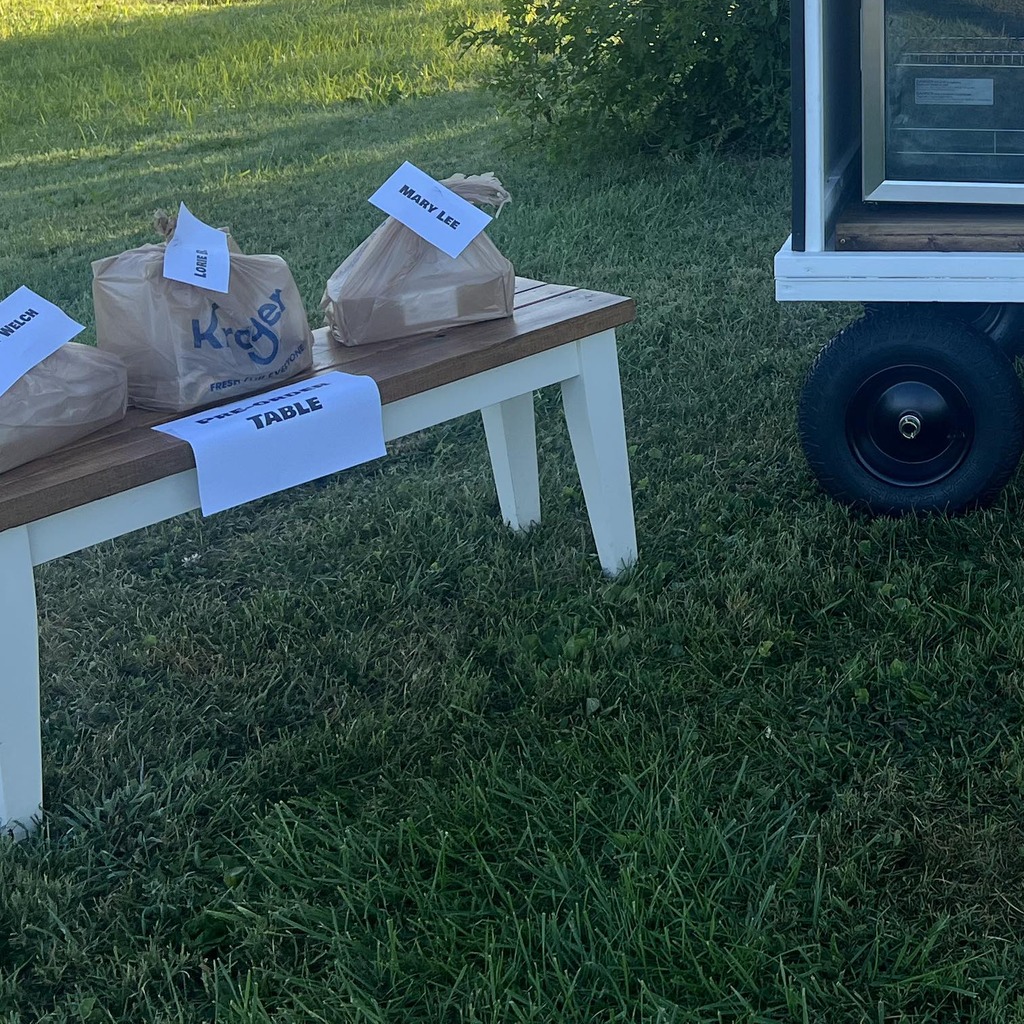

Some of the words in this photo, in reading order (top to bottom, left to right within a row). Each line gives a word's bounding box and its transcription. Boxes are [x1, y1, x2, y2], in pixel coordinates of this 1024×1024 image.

[398, 184, 438, 213] MARY
[436, 210, 461, 230] LEE
[194, 255, 208, 279] LORIE
[0, 308, 39, 337] WELCH
[191, 288, 286, 366] Kroger
[210, 379, 240, 392] FRESH
[195, 382, 331, 425] PRE-ORDER
[246, 396, 323, 430] TABLE
